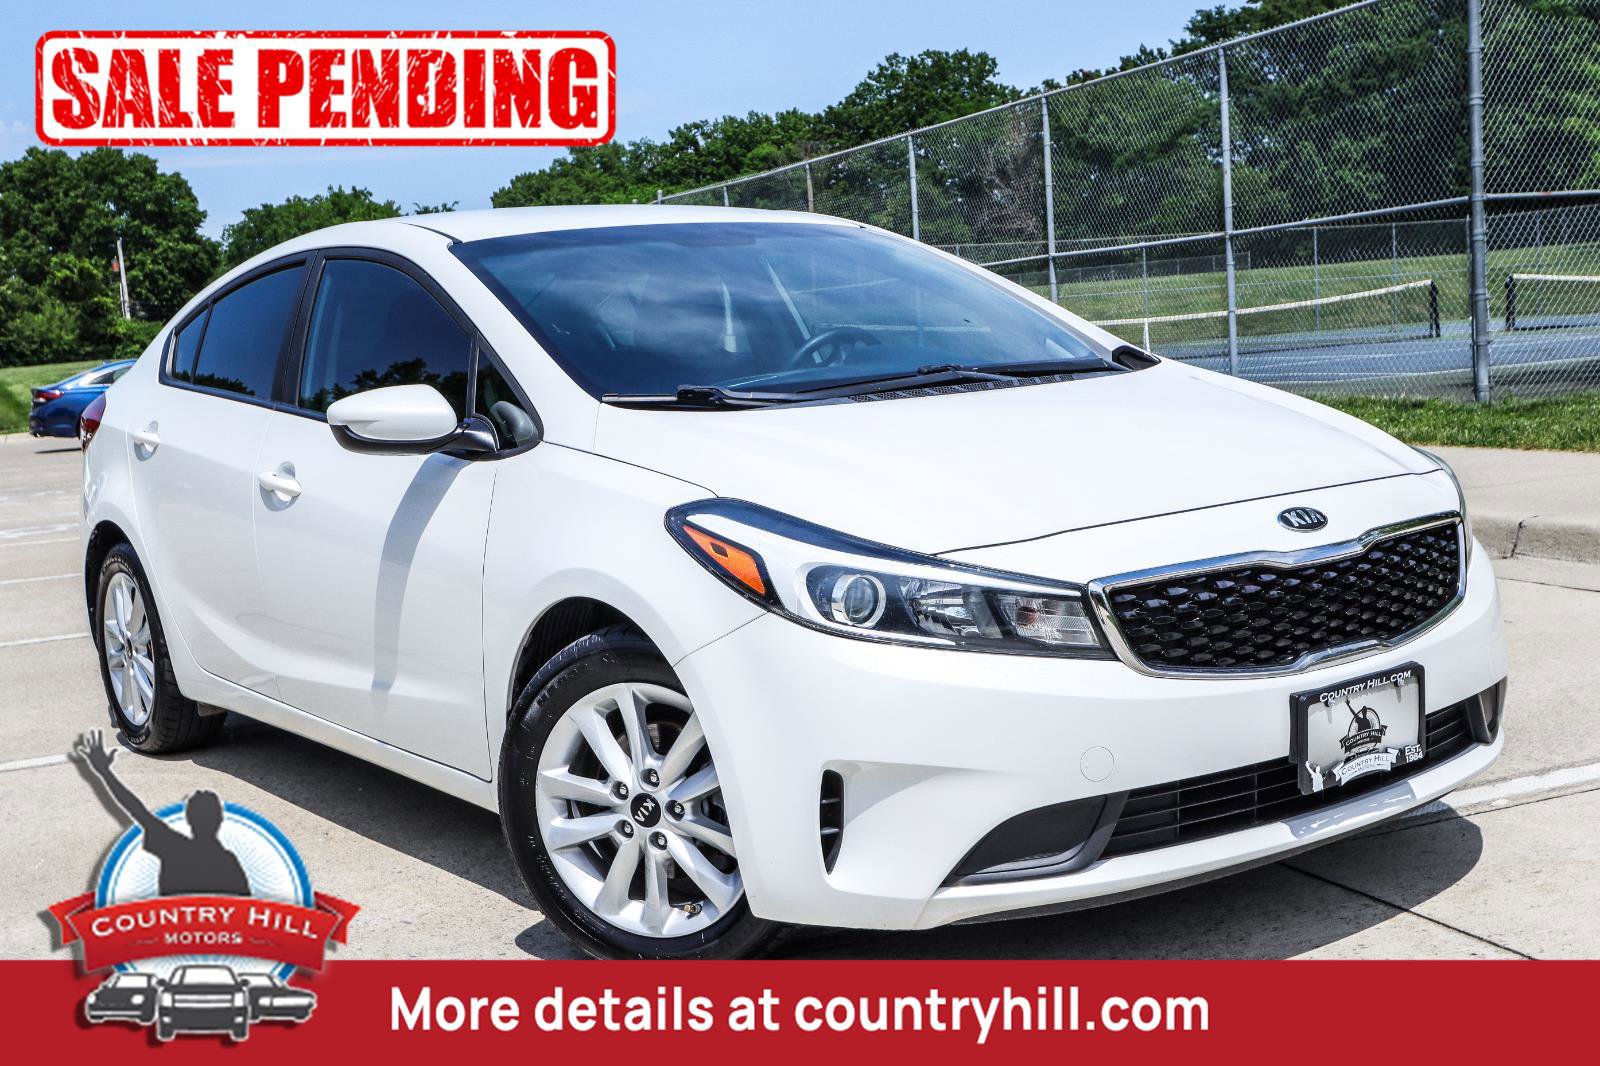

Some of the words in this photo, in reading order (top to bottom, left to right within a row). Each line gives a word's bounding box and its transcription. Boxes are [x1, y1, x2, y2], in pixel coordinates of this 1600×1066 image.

[1283, 508, 1324, 527] KIA
[1405, 751, 1423, 763] 1984
[634, 797, 656, 822] KIA
